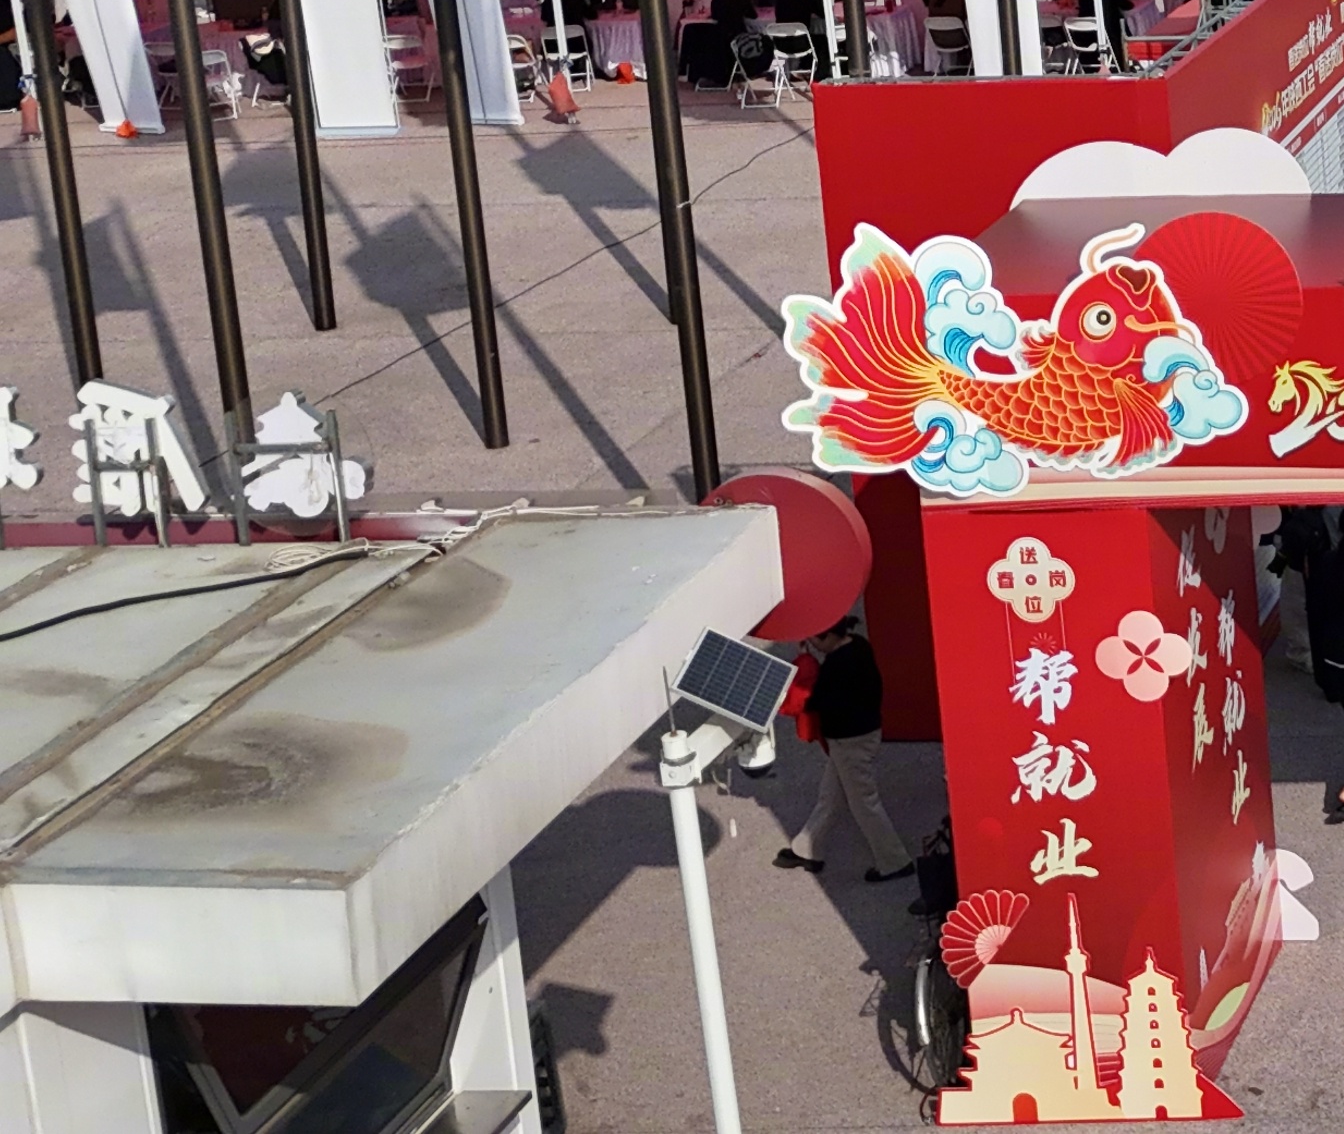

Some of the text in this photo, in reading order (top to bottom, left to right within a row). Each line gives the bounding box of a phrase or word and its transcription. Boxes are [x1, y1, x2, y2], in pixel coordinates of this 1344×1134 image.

[1009, 647, 1100, 885] 帮就业
[1176, 524, 1215, 777] 促发展
[1217, 589, 1251, 825] 帮就业
